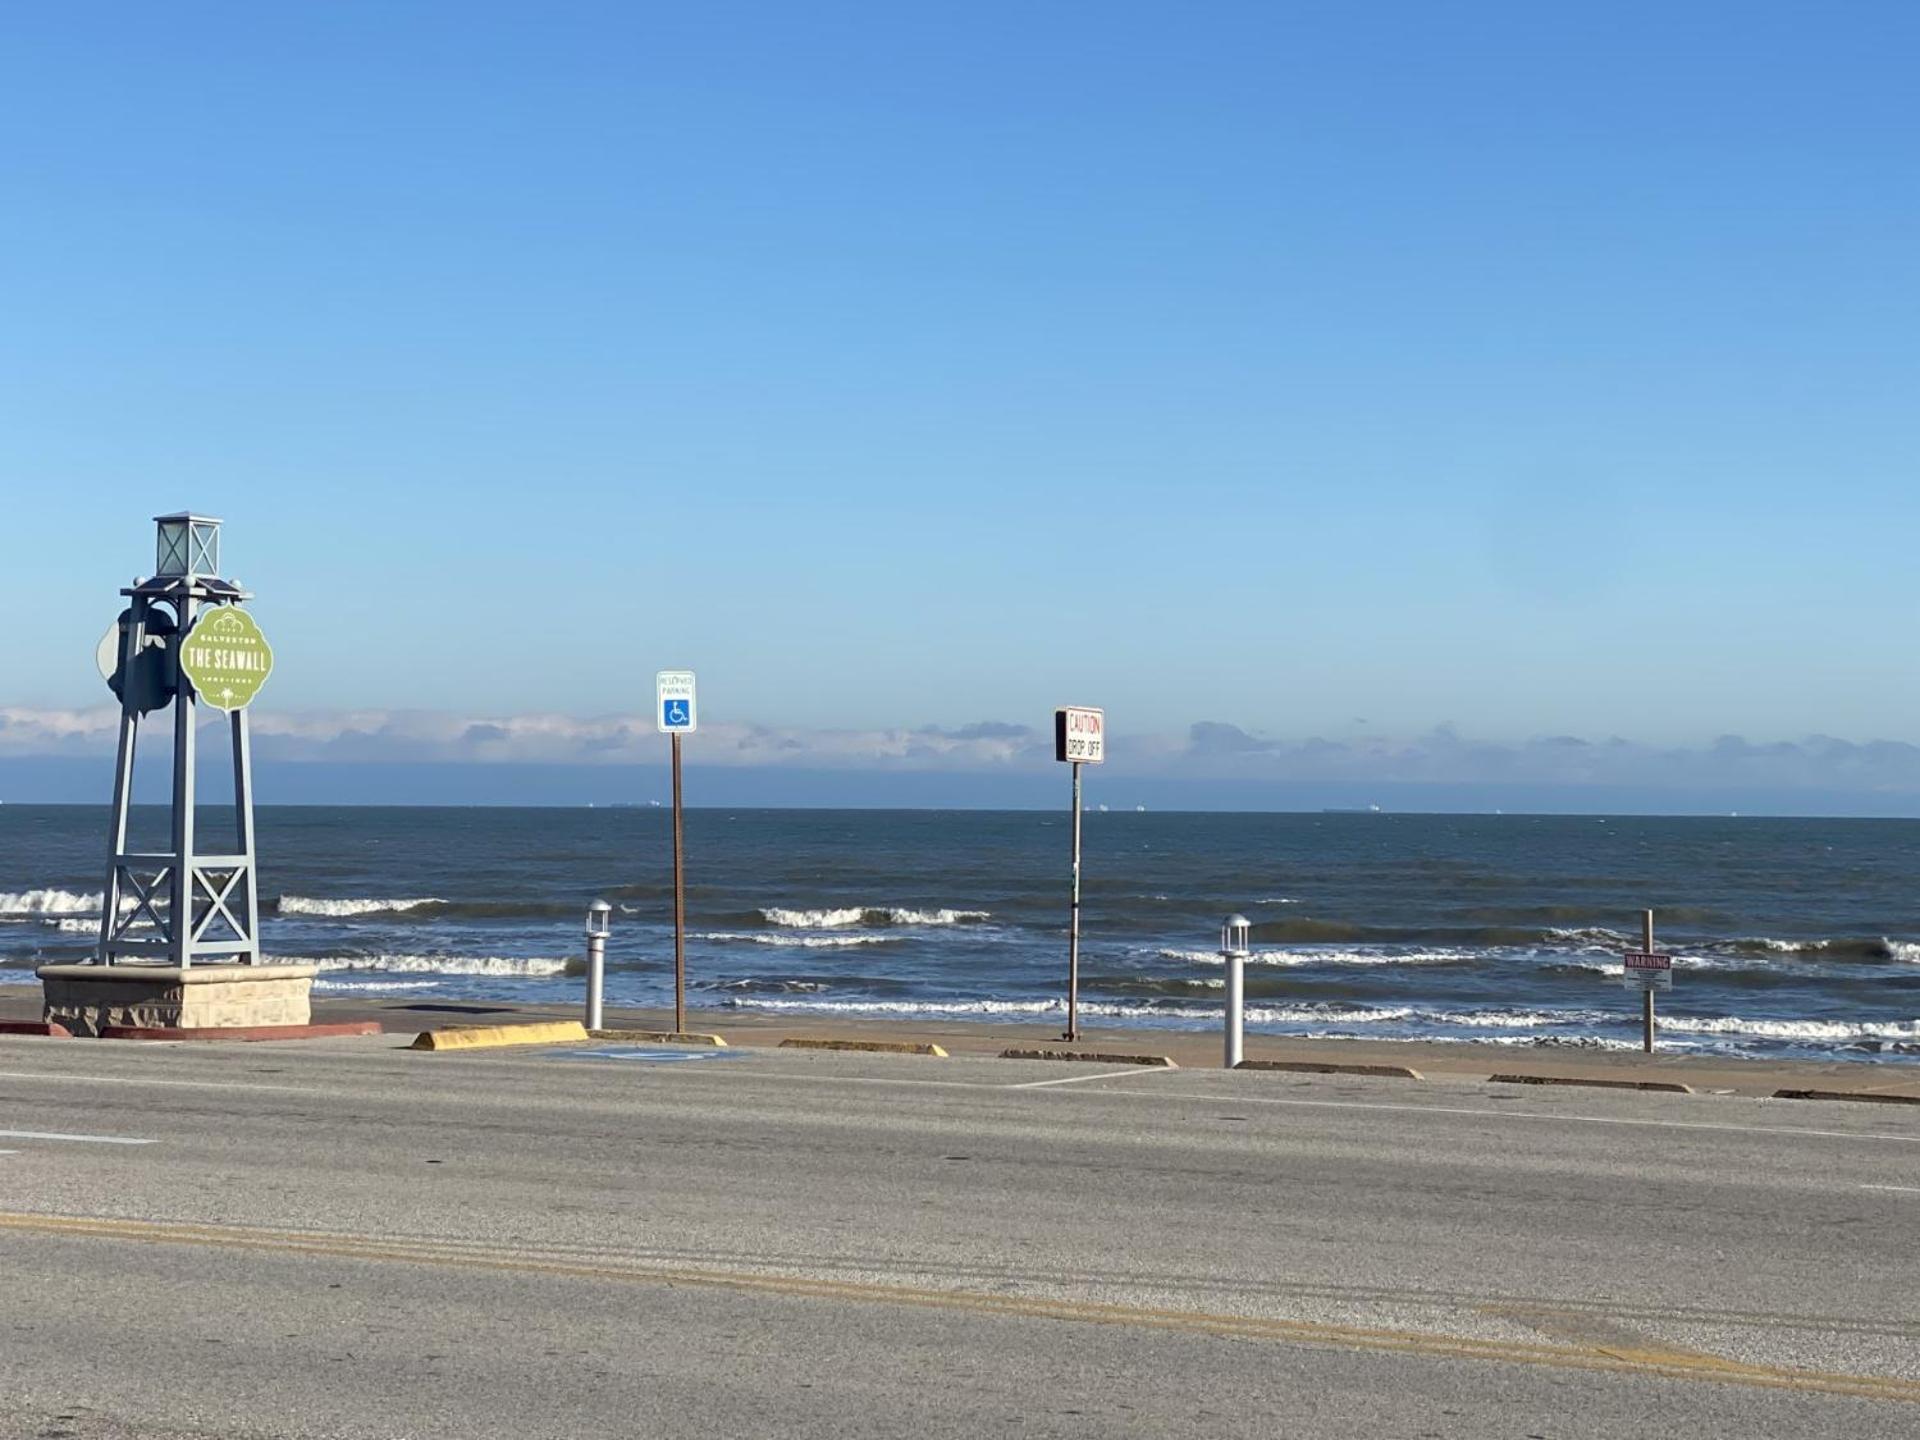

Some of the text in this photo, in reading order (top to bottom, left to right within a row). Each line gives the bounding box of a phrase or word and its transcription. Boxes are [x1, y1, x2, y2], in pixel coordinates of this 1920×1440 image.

[200, 634, 256, 644] GALVESTON
[189, 647, 267, 673] THE SEAWALL
[662, 687, 690, 695] PARKING
[1070, 713, 1101, 734] CAUTION
[1068, 738, 1101, 756] DROP OFF
[1626, 955, 1669, 969] WARNING
